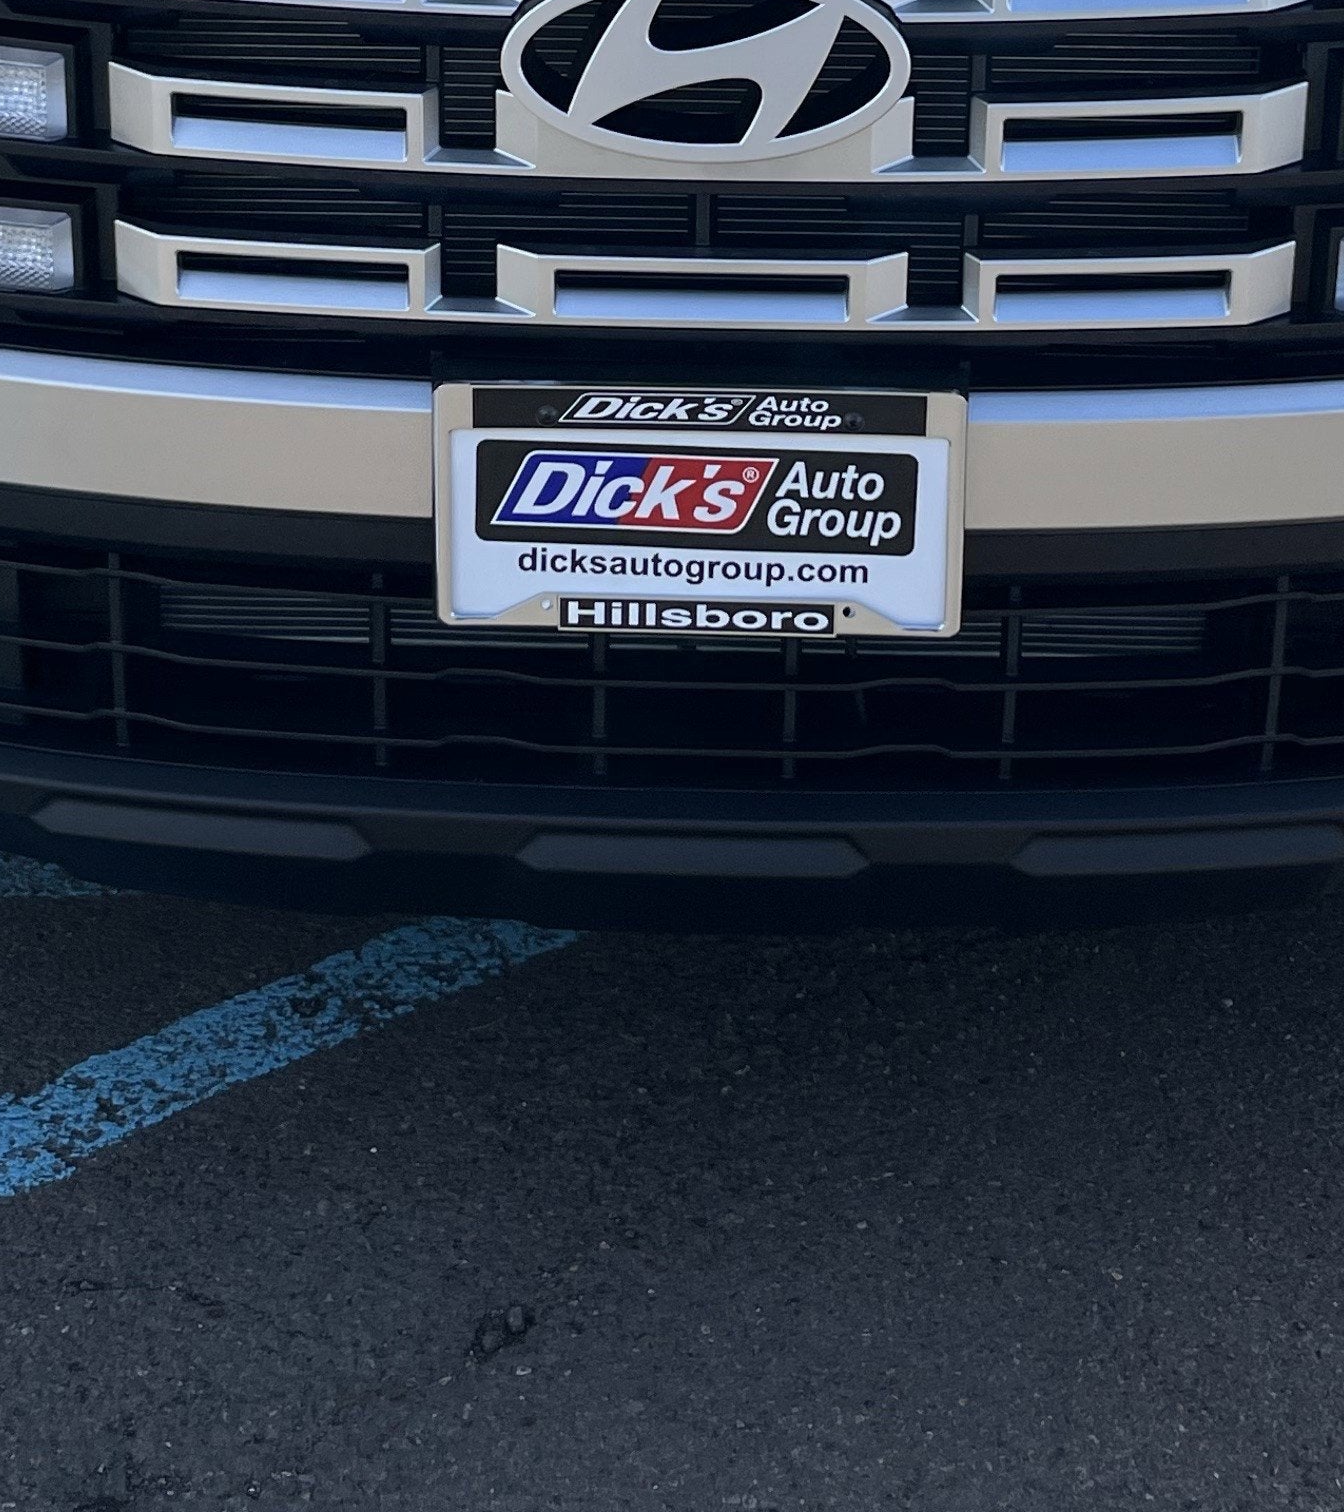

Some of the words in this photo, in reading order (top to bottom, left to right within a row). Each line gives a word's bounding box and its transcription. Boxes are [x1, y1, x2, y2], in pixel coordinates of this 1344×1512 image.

[572, 396, 734, 421] Dick's
[748, 411, 842, 431] Group
[755, 396, 829, 413] Auto
[513, 460, 745, 523] Dick's
[775, 462, 885, 501] Auto
[766, 498, 902, 547] Group
[517, 547, 869, 587] dicksautogroup.com
[567, 601, 829, 631] Hillsboro
